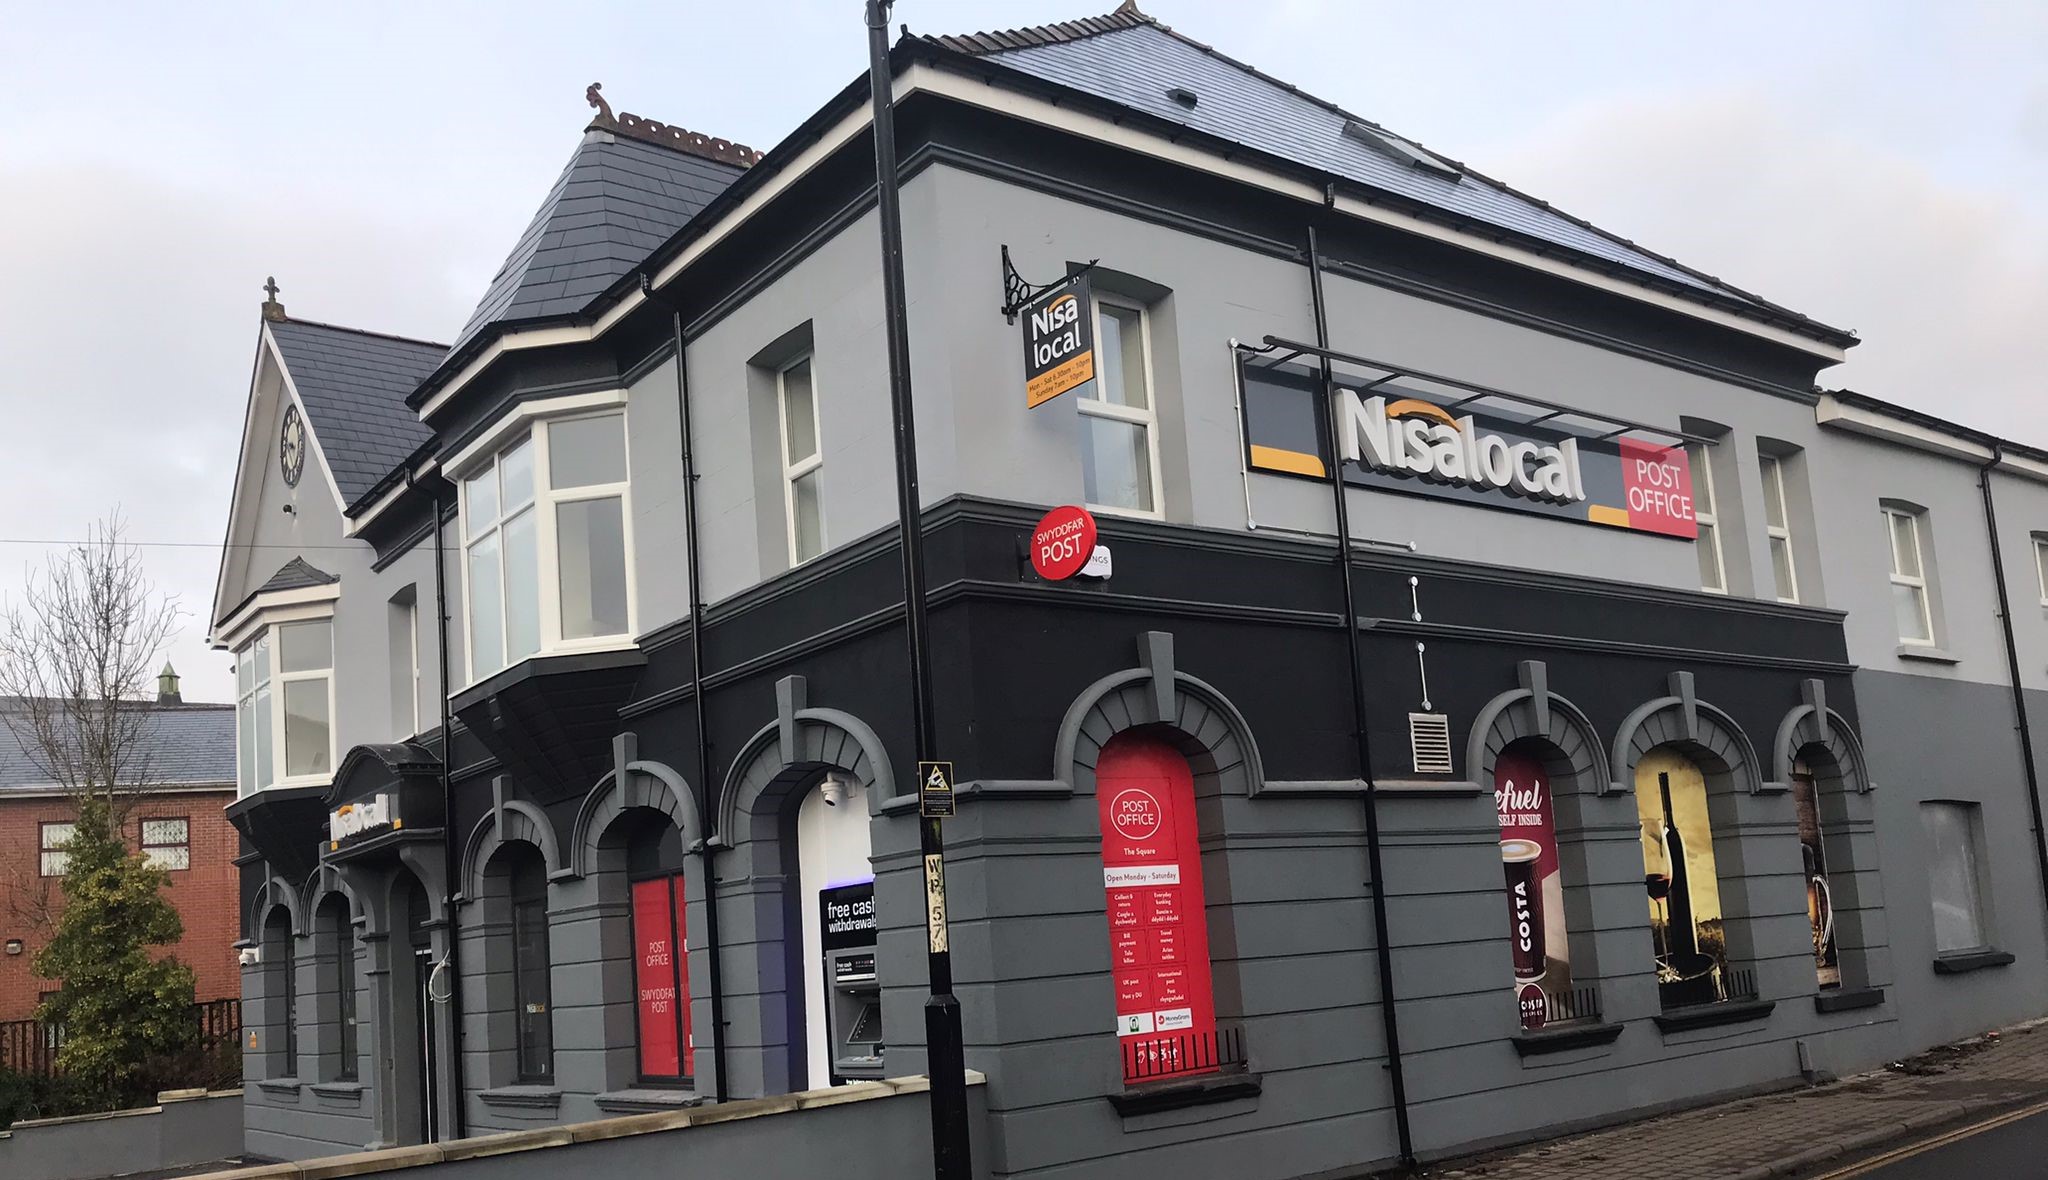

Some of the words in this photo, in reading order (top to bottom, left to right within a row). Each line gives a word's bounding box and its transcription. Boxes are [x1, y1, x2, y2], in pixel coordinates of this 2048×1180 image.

[1031, 294, 1078, 341] Nisa
[1033, 321, 1082, 369] local
[1035, 386, 1054, 399] Sunday
[1636, 459, 1680, 490] POST
[1629, 486, 1693, 520] OFFICE
[1036, 517, 1085, 545] SWYDDFAR
[1041, 532, 1082, 567] POST
[1122, 800, 1149, 812] POST
[1117, 813, 1155, 826] OFFICE
[1517, 813, 1543, 826] INSIDE
[1124, 847, 1135, 855] The
[1136, 847, 1156, 857] Square
[1106, 874, 1123, 883] Open
[1124, 872, 1147, 882] Monday
[1151, 870, 1177, 881] Saturday
[828, 901, 850, 919] free
[1514, 881, 1532, 952] COSTA
[649, 941, 666, 953] POST
[646, 954, 669, 967] OFFICE
[651, 1001, 668, 1013] POST
